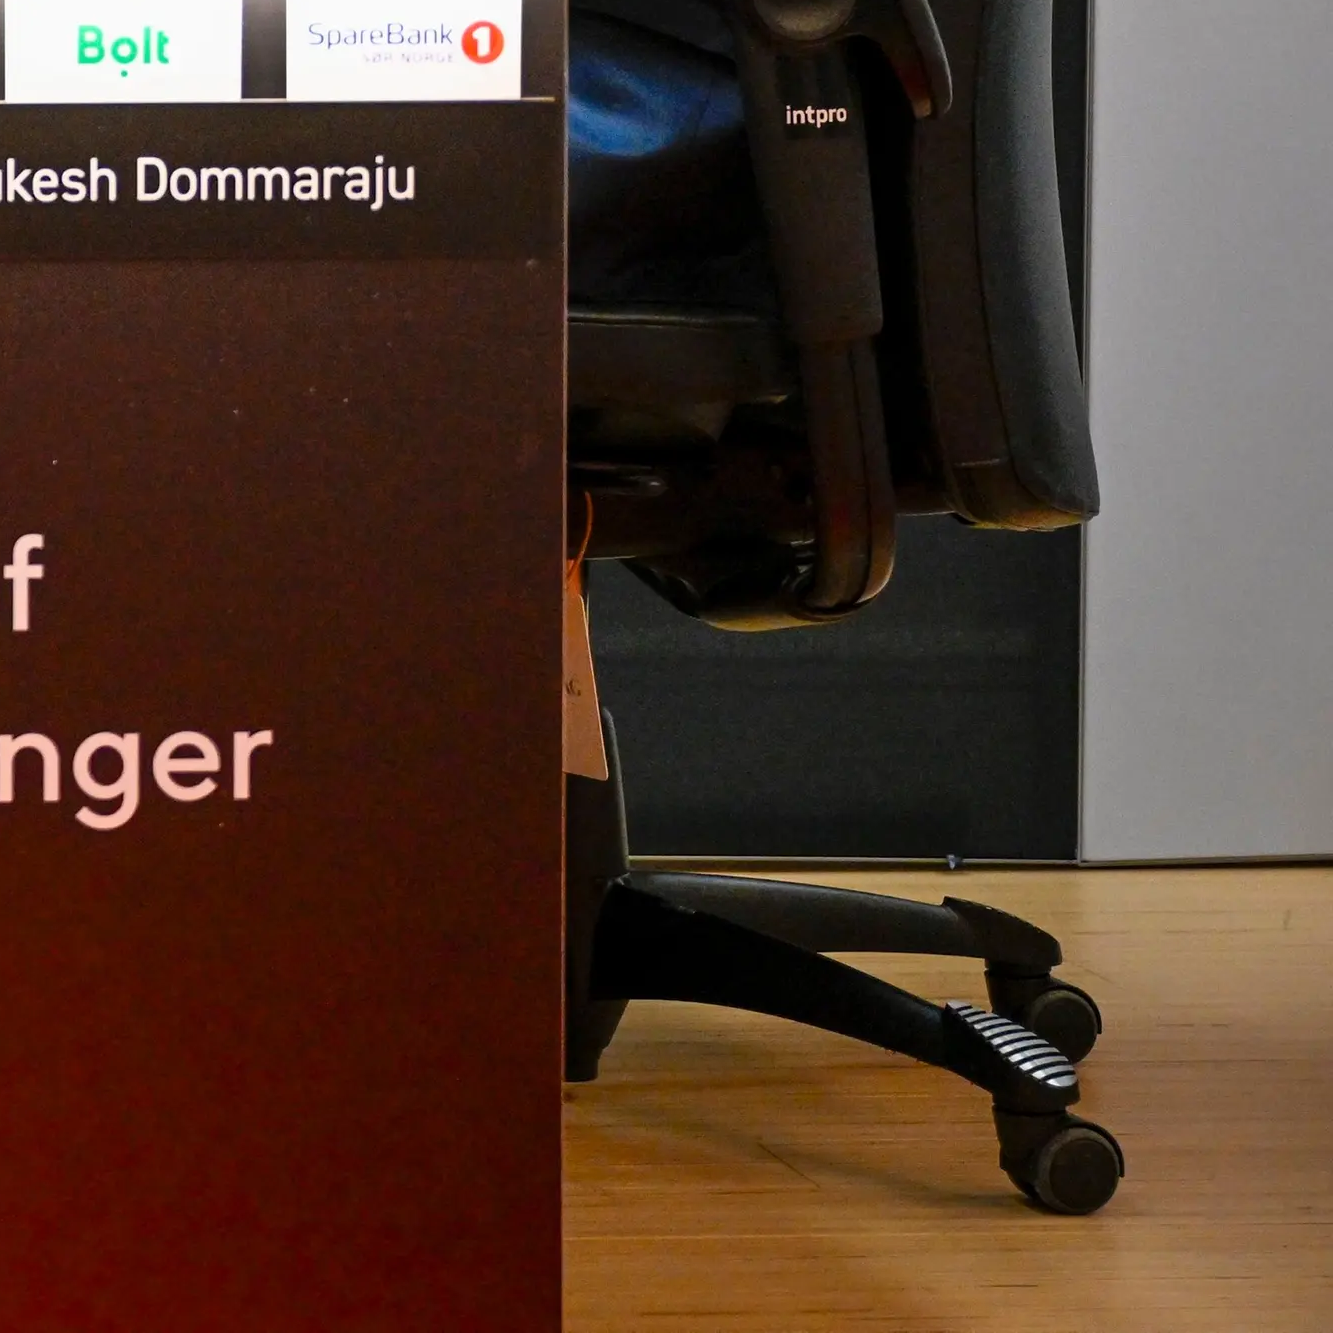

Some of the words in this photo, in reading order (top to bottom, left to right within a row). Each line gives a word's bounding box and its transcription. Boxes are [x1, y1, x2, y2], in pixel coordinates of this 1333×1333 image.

[78, 26, 169, 77] Bolt
[309, 24, 452, 49] SpareBank
[787, 106, 847, 128] intpro
[137, 155, 414, 211] Dommaraju
